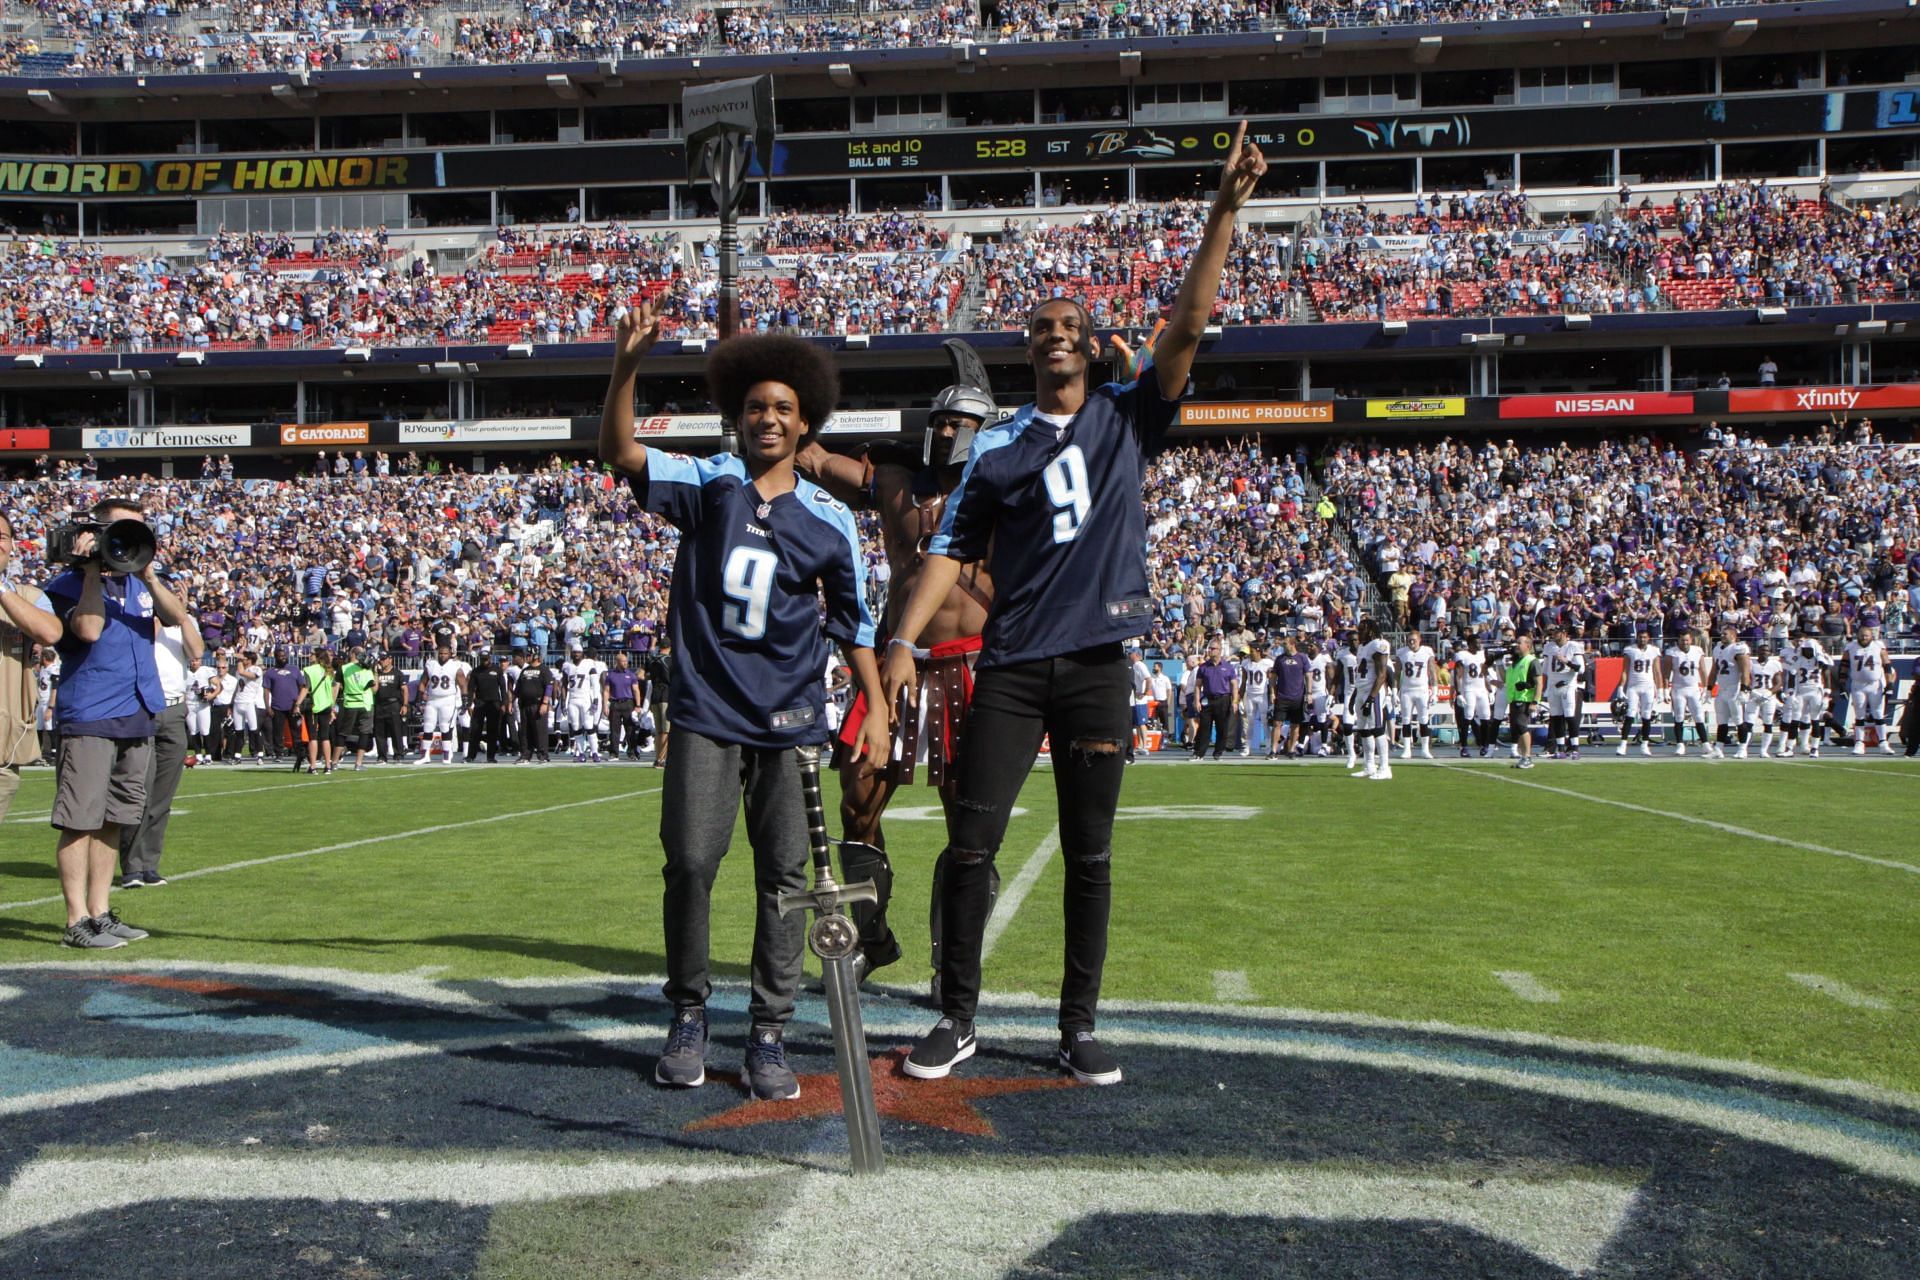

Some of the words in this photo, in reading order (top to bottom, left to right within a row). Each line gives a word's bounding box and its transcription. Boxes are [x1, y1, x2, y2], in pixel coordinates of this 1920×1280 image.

[1254, 134, 1273, 144] TOL
[1277, 133, 1285, 143] 3
[872, 140, 900, 154] and
[976, 139, 1027, 158] 5:28
[849, 157, 874, 168] BALL
[877, 156, 891, 167] ON
[901, 155, 918, 166] 35
[156, 161, 222, 192] OF
[233, 156, 408, 190] HONOR
[737, 257, 763, 268] ITANS
[1555, 398, 1635, 412] NISSAN
[1797, 388, 1860, 410] xfinity
[1186, 409, 1250, 420] BUILDING
[1255, 406, 1327, 419] PRODUCTS
[404, 424, 448, 435] RJYoung
[640, 418, 671, 430] LEE
[129, 430, 147, 446] of
[151, 430, 238, 446] Tennessee
[283, 427, 296, 442] G
[300, 428, 366, 440] GATORADE
[1043, 445, 1092, 543] 9
[745, 523, 773, 538] TITANS
[722, 546, 778, 640] 9
[1404, 661, 1424, 678] 87
[1633, 659, 1650, 673] 81
[1679, 660, 1695, 676] 61
[1854, 655, 1875, 672] 74
[430, 675, 450, 691] 98
[568, 673, 586, 688] 57
[1249, 670, 1264, 686] 10
[1754, 673, 1770, 689] 31
